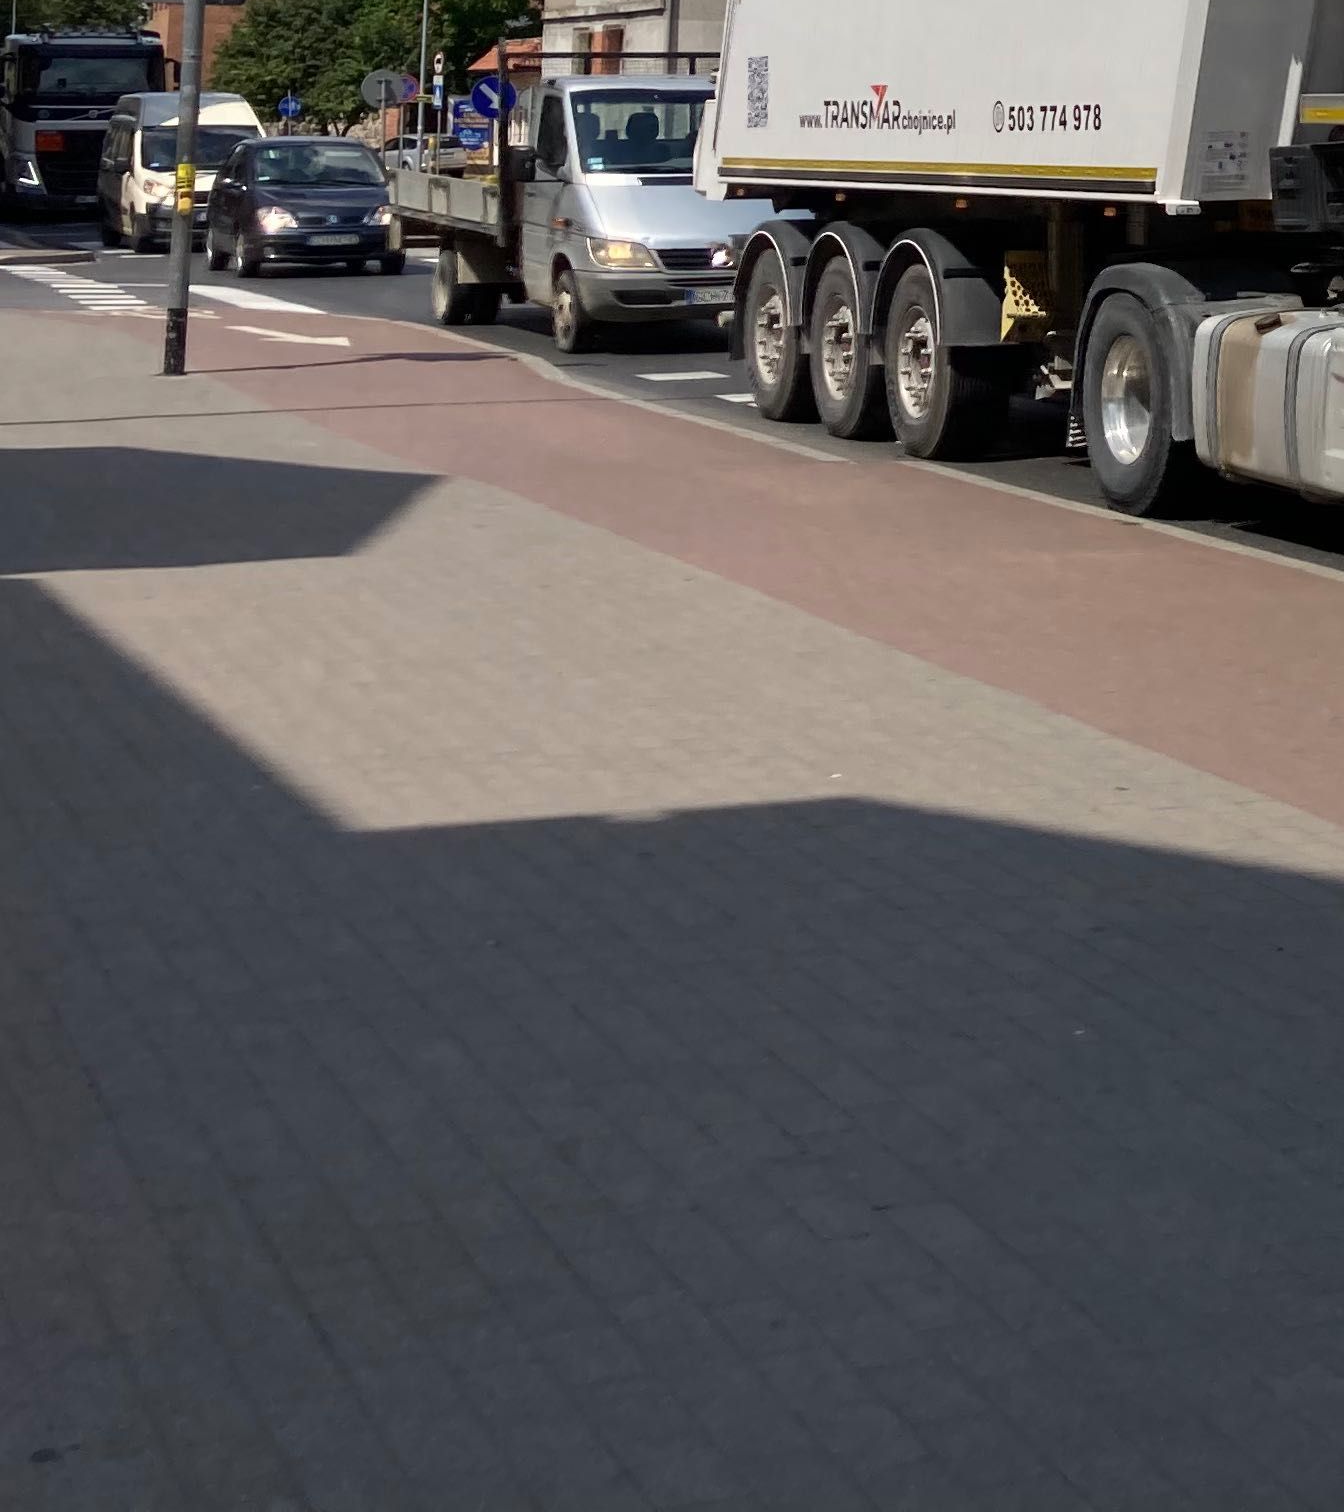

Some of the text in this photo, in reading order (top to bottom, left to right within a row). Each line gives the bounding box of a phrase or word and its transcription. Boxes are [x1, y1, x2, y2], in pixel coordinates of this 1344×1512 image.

[1008, 104, 1102, 131] 503 774 978
